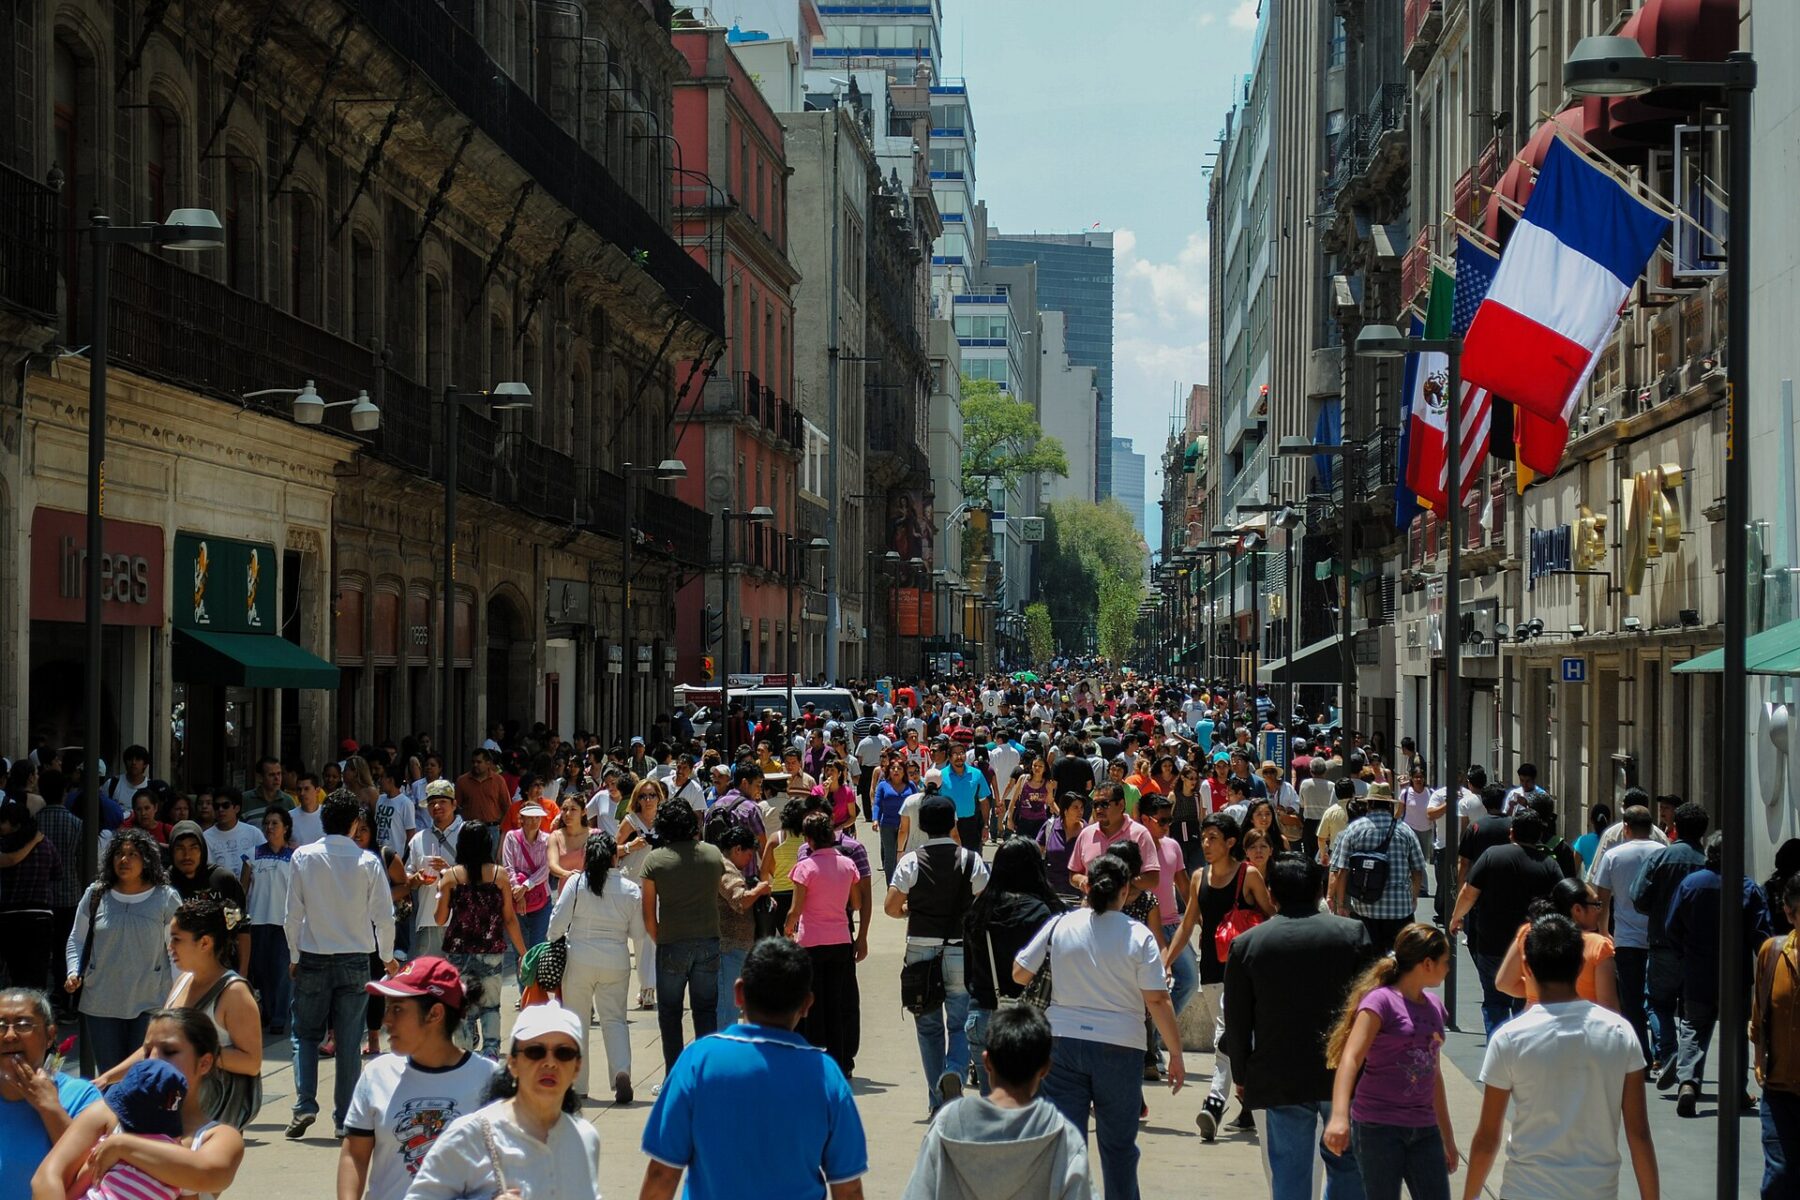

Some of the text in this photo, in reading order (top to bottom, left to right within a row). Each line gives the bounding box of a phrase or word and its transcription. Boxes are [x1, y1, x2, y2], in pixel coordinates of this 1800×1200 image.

[1567, 662, 1581, 678] H
[988, 697, 994, 707] 8
[376, 804, 395, 817] SUD
